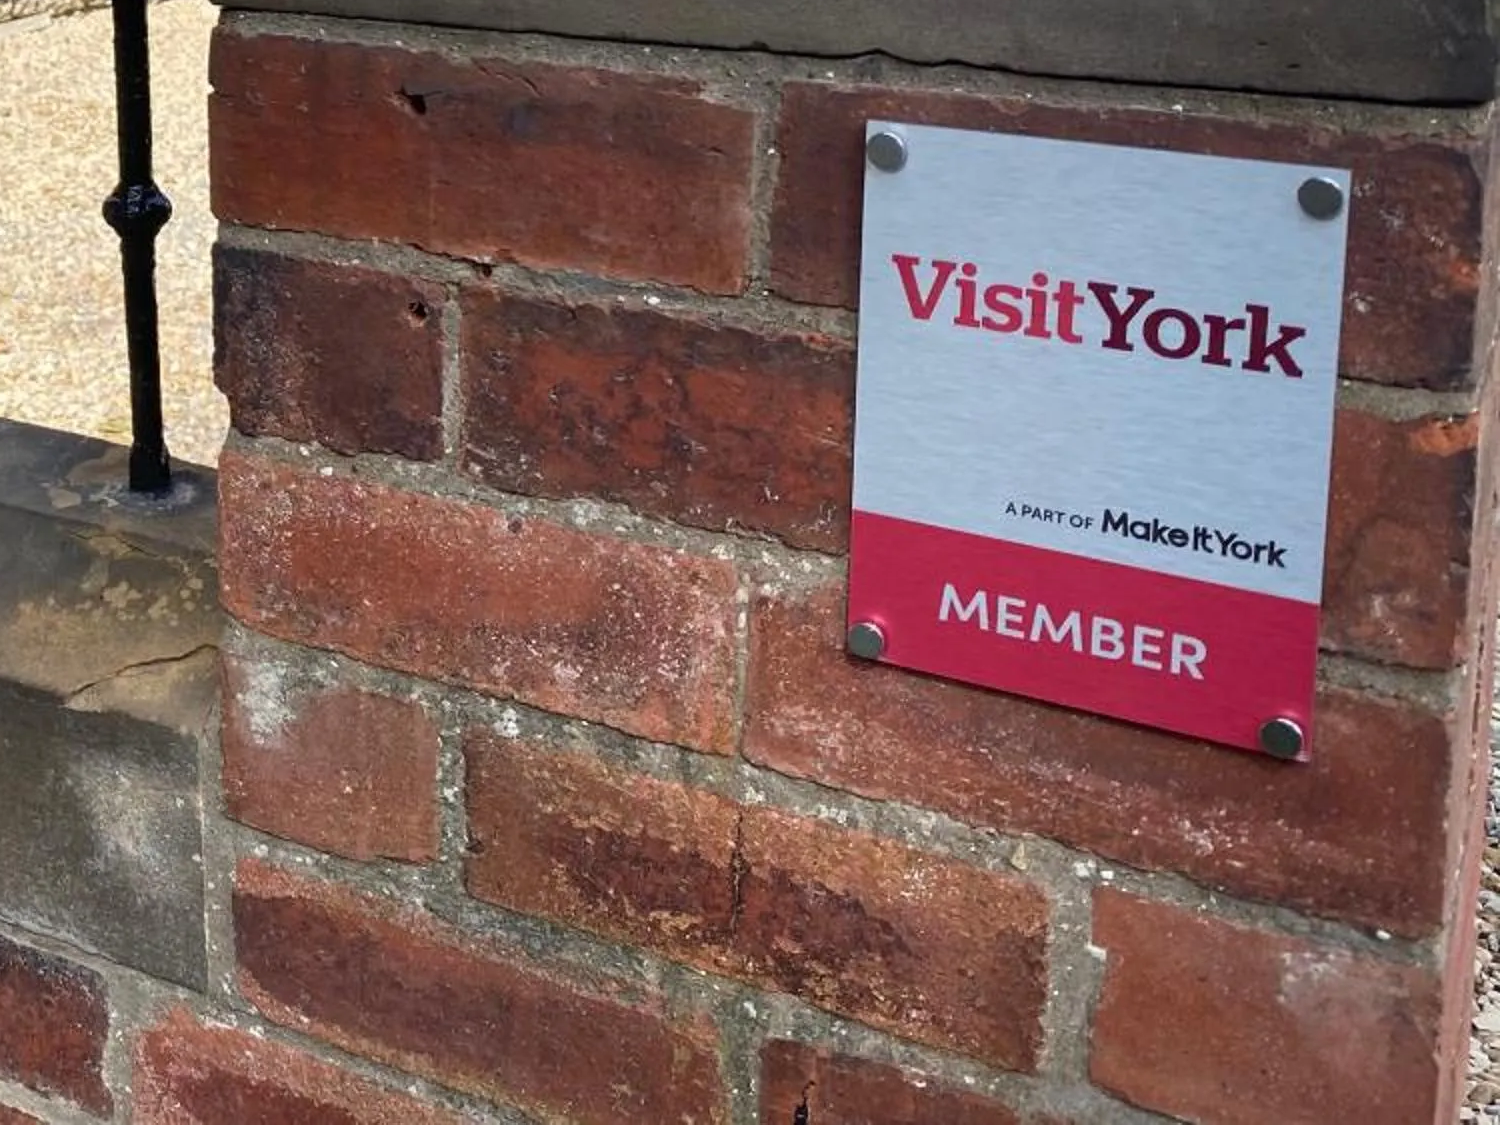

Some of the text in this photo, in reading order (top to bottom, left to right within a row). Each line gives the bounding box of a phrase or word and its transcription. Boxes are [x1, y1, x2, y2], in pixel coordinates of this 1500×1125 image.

[891, 253, 1307, 379] VisitYork
[1005, 502, 1017, 516] A
[1021, 504, 1065, 525] PART
[1069, 514, 1094, 529] OF
[938, 584, 1208, 681] MEMBER
